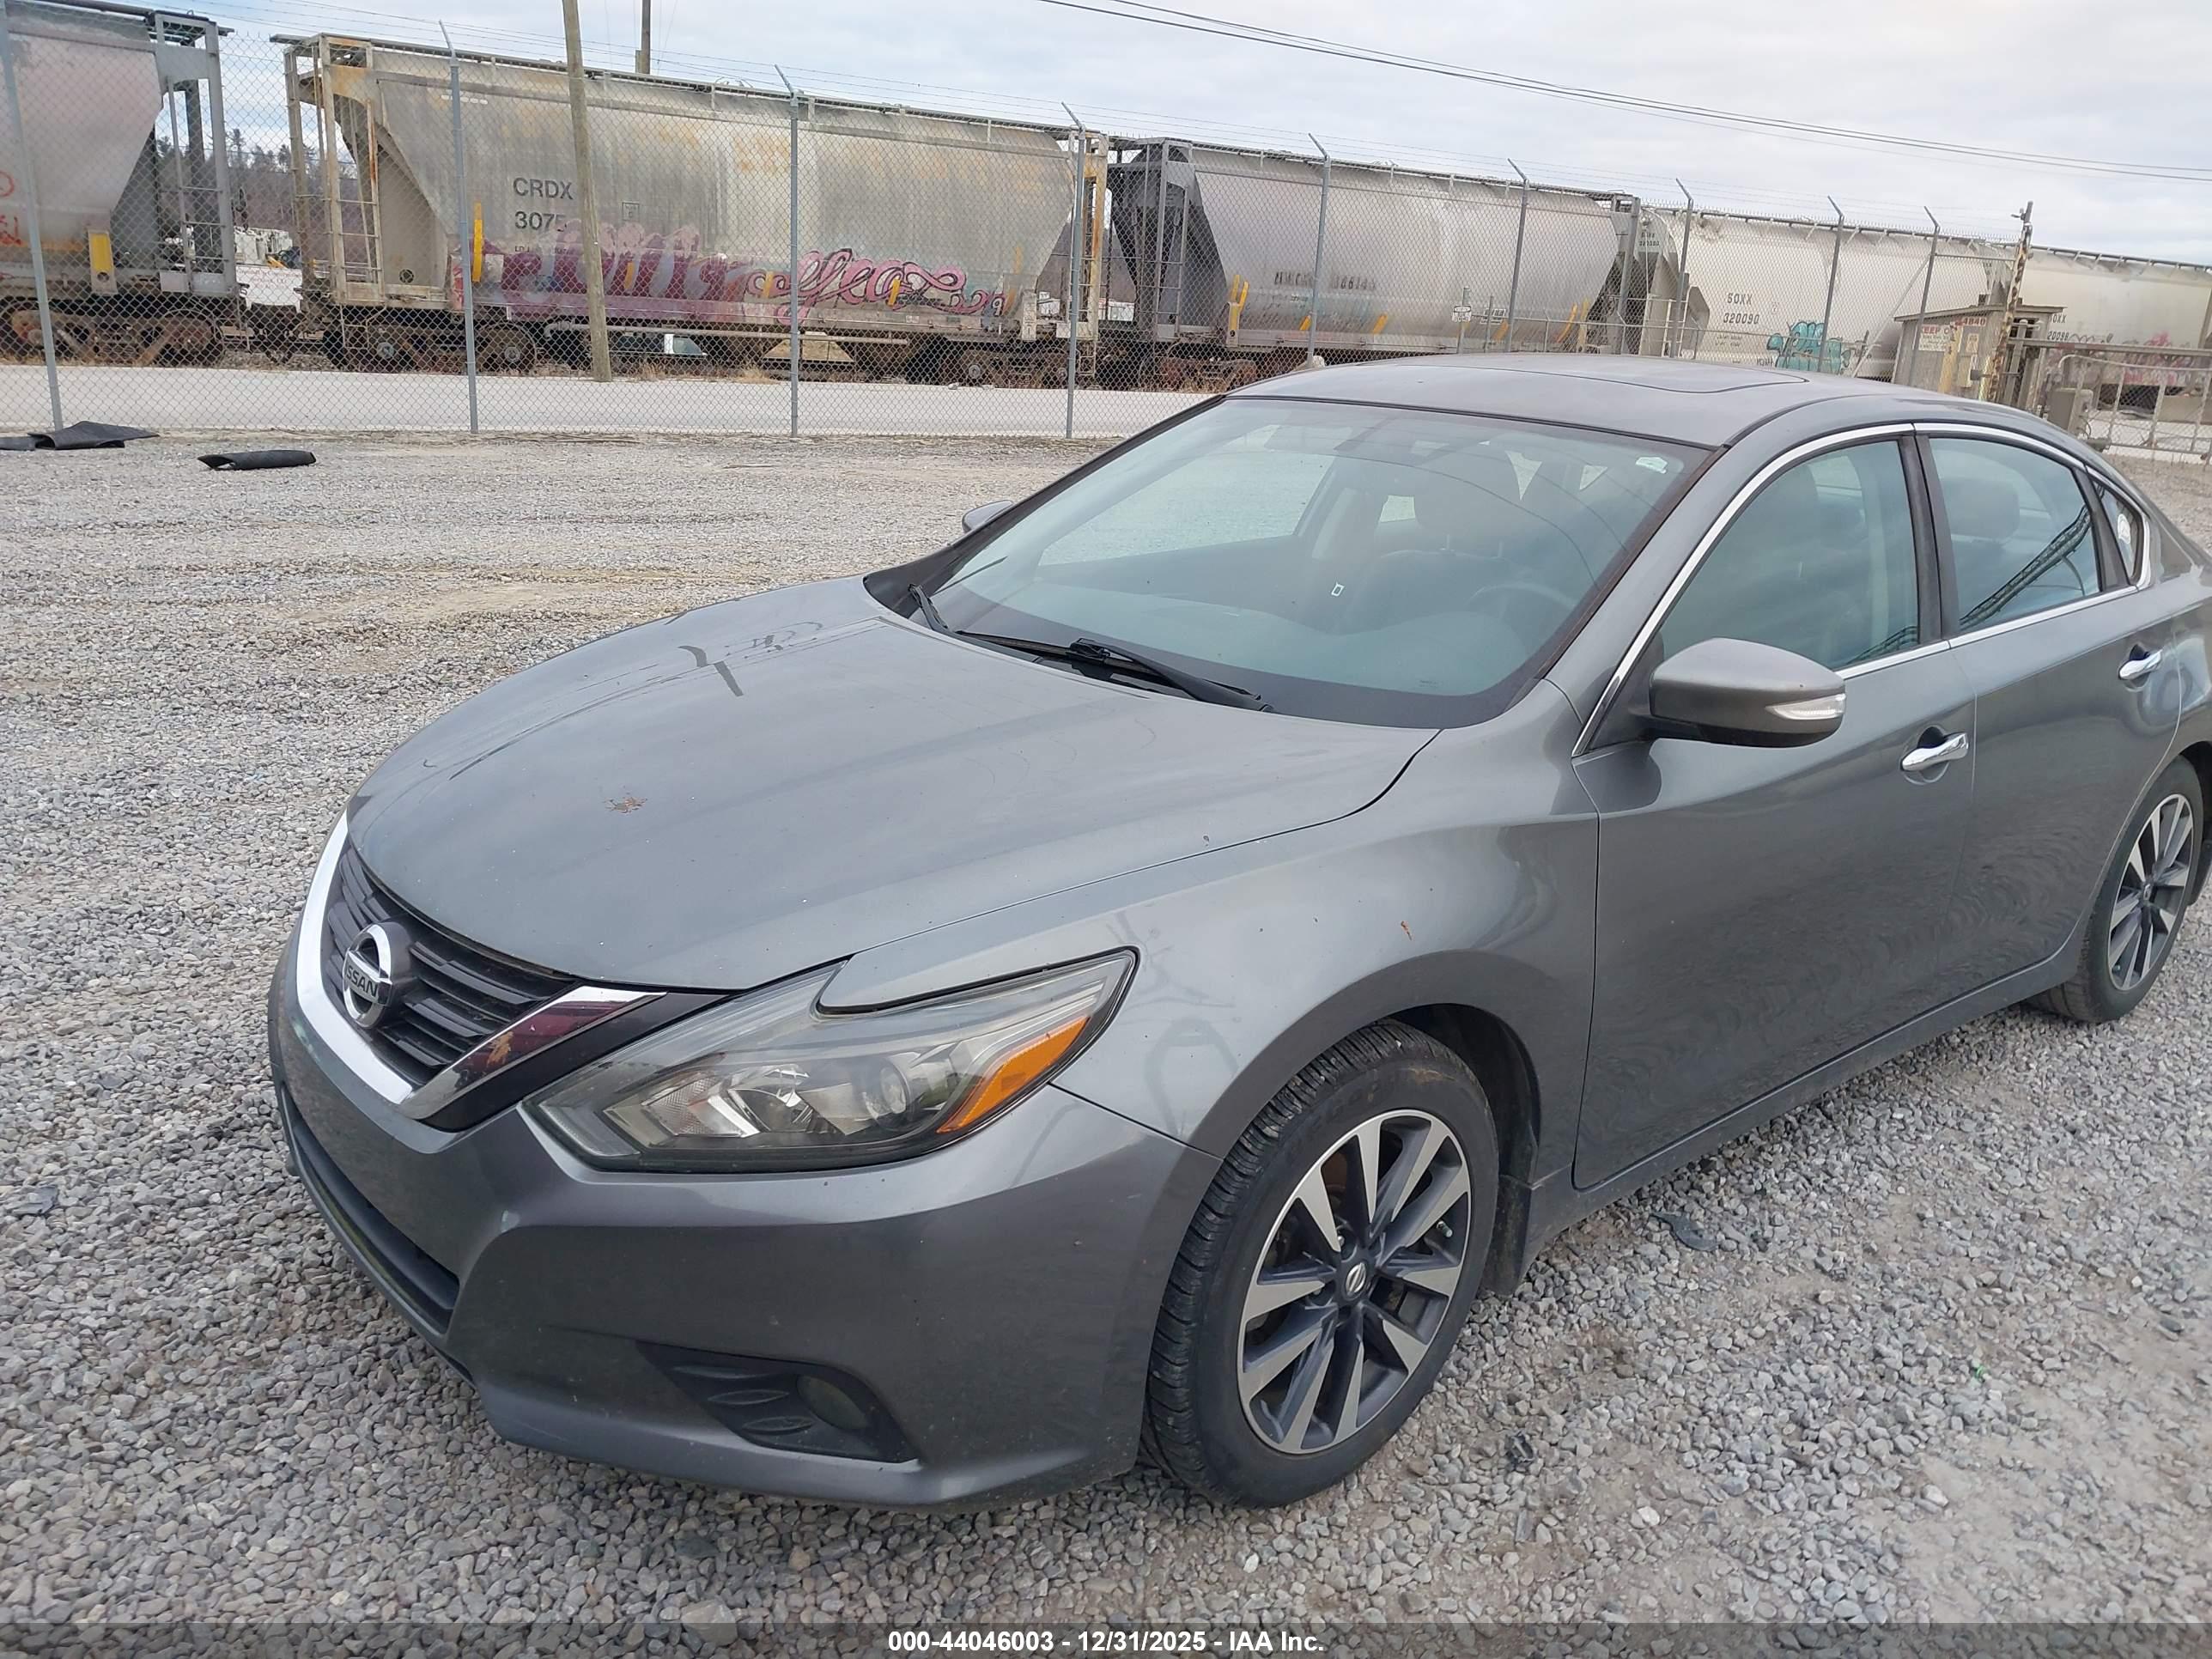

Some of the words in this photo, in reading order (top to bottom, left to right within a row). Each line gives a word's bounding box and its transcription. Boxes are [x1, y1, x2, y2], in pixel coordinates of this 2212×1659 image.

[514, 177, 573, 200] CRDX
[1723, 313, 1760, 325] 320090
[346, 964, 378, 998] SSAN
